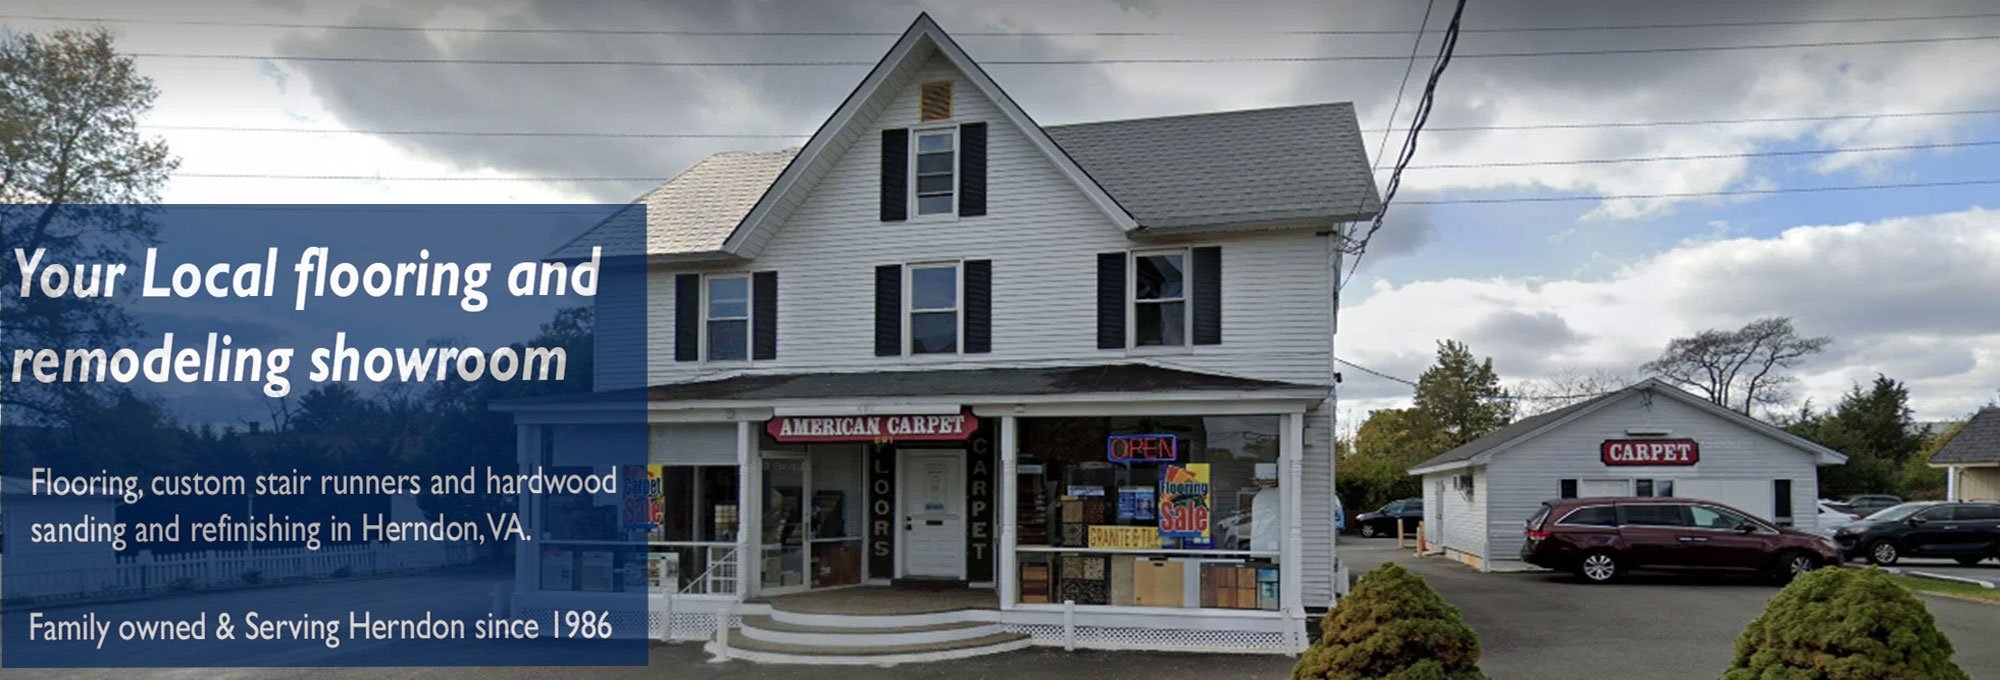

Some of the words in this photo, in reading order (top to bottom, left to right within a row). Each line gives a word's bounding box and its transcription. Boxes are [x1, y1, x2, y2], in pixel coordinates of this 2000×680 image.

[779, 417, 881, 435] AMERICAN
[886, 415, 965, 435] CARPET
[1111, 437, 1176, 460] OPEN
[1609, 443, 1691, 461] CARPET
[971, 438, 987, 560] CARPET
[1160, 482, 1208, 495] Flooring
[625, 496, 665, 525] Sale
[1160, 502, 1208, 531] Sale
[1090, 527, 1130, 547] GRANITE
